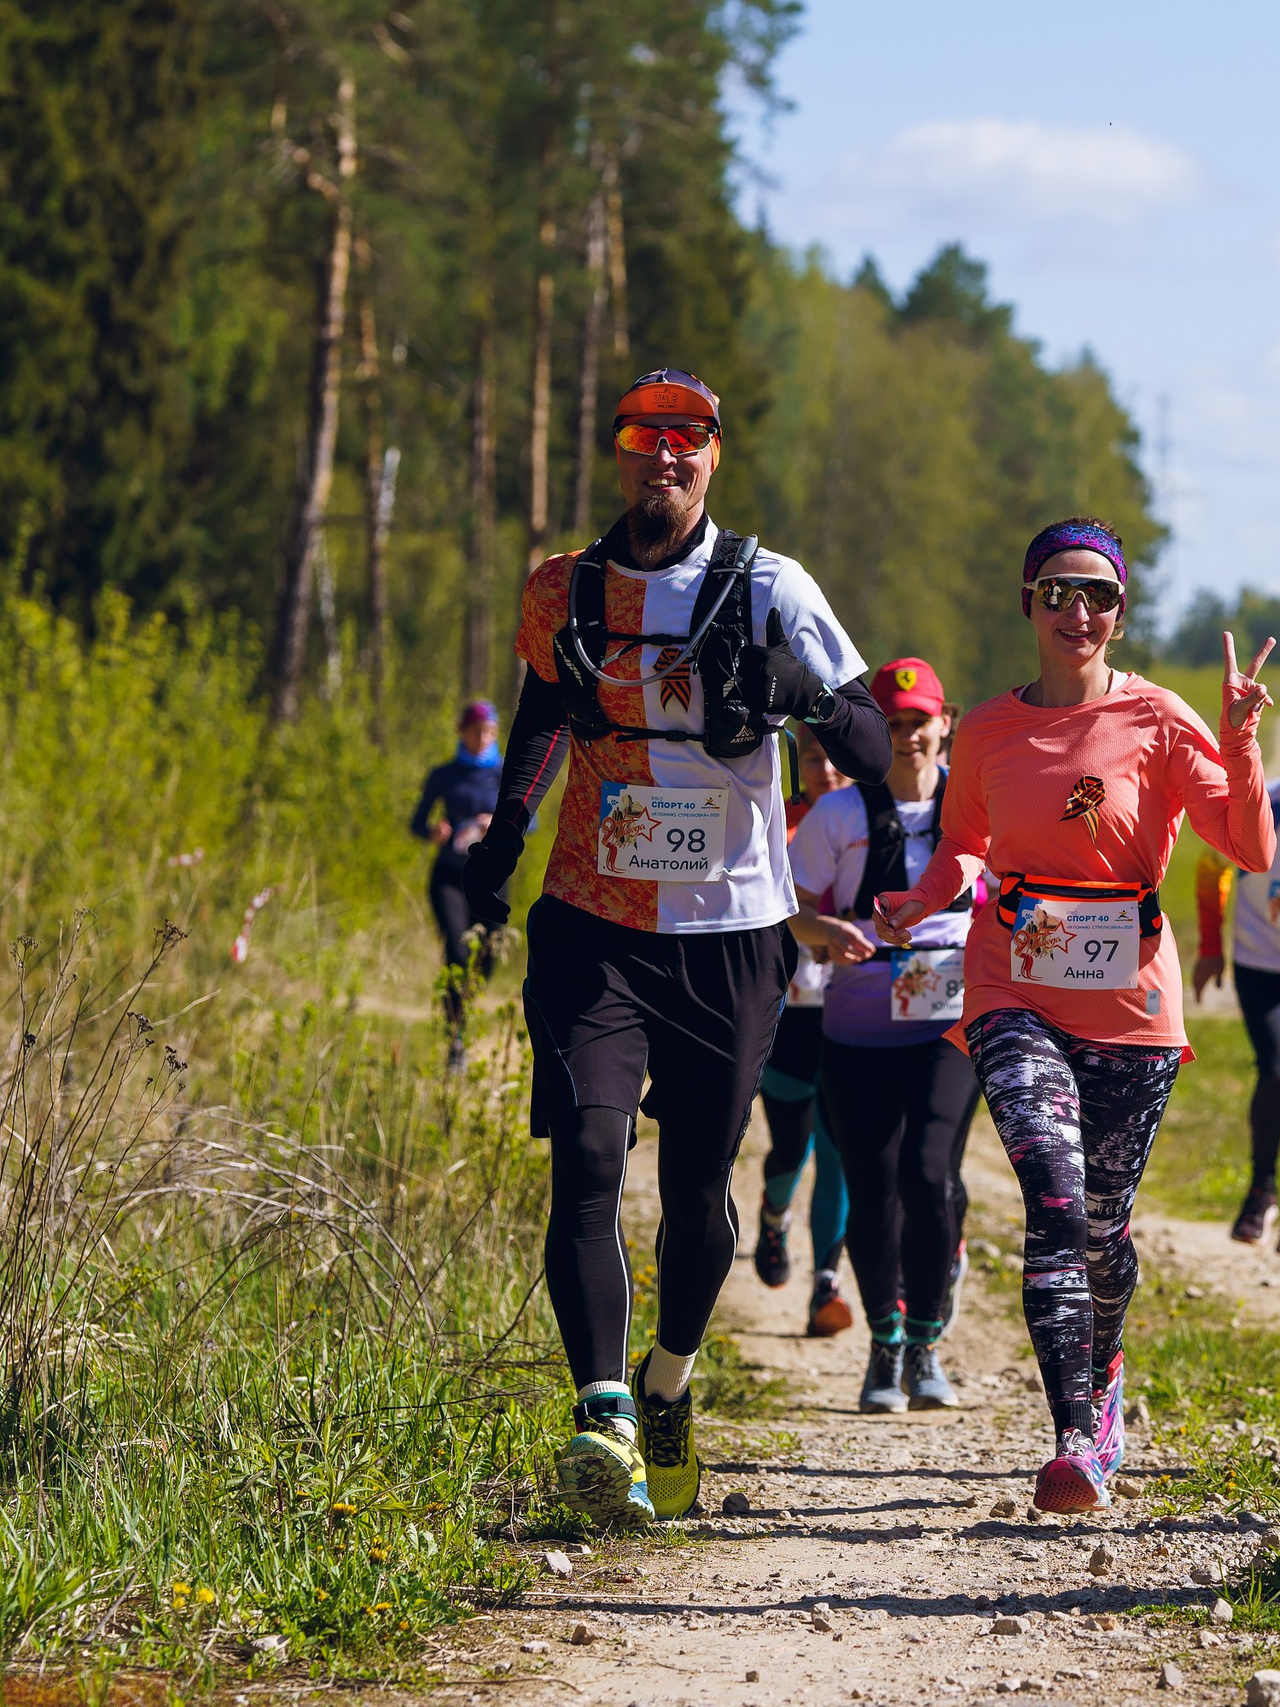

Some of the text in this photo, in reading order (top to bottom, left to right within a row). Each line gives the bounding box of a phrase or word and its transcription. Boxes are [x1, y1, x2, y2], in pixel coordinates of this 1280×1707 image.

[654, 394, 669, 402] STAY
[768, 675, 778, 708] SPORT
[651, 801, 683, 810] СПОРТ
[683, 802, 696, 810] 40
[666, 828, 706, 853] 98
[628, 854, 708, 870] Анатолий
[1083, 939, 1119, 963] 97
[1063, 966, 1105, 979] Анна
[945, 979, 964, 999] 8
